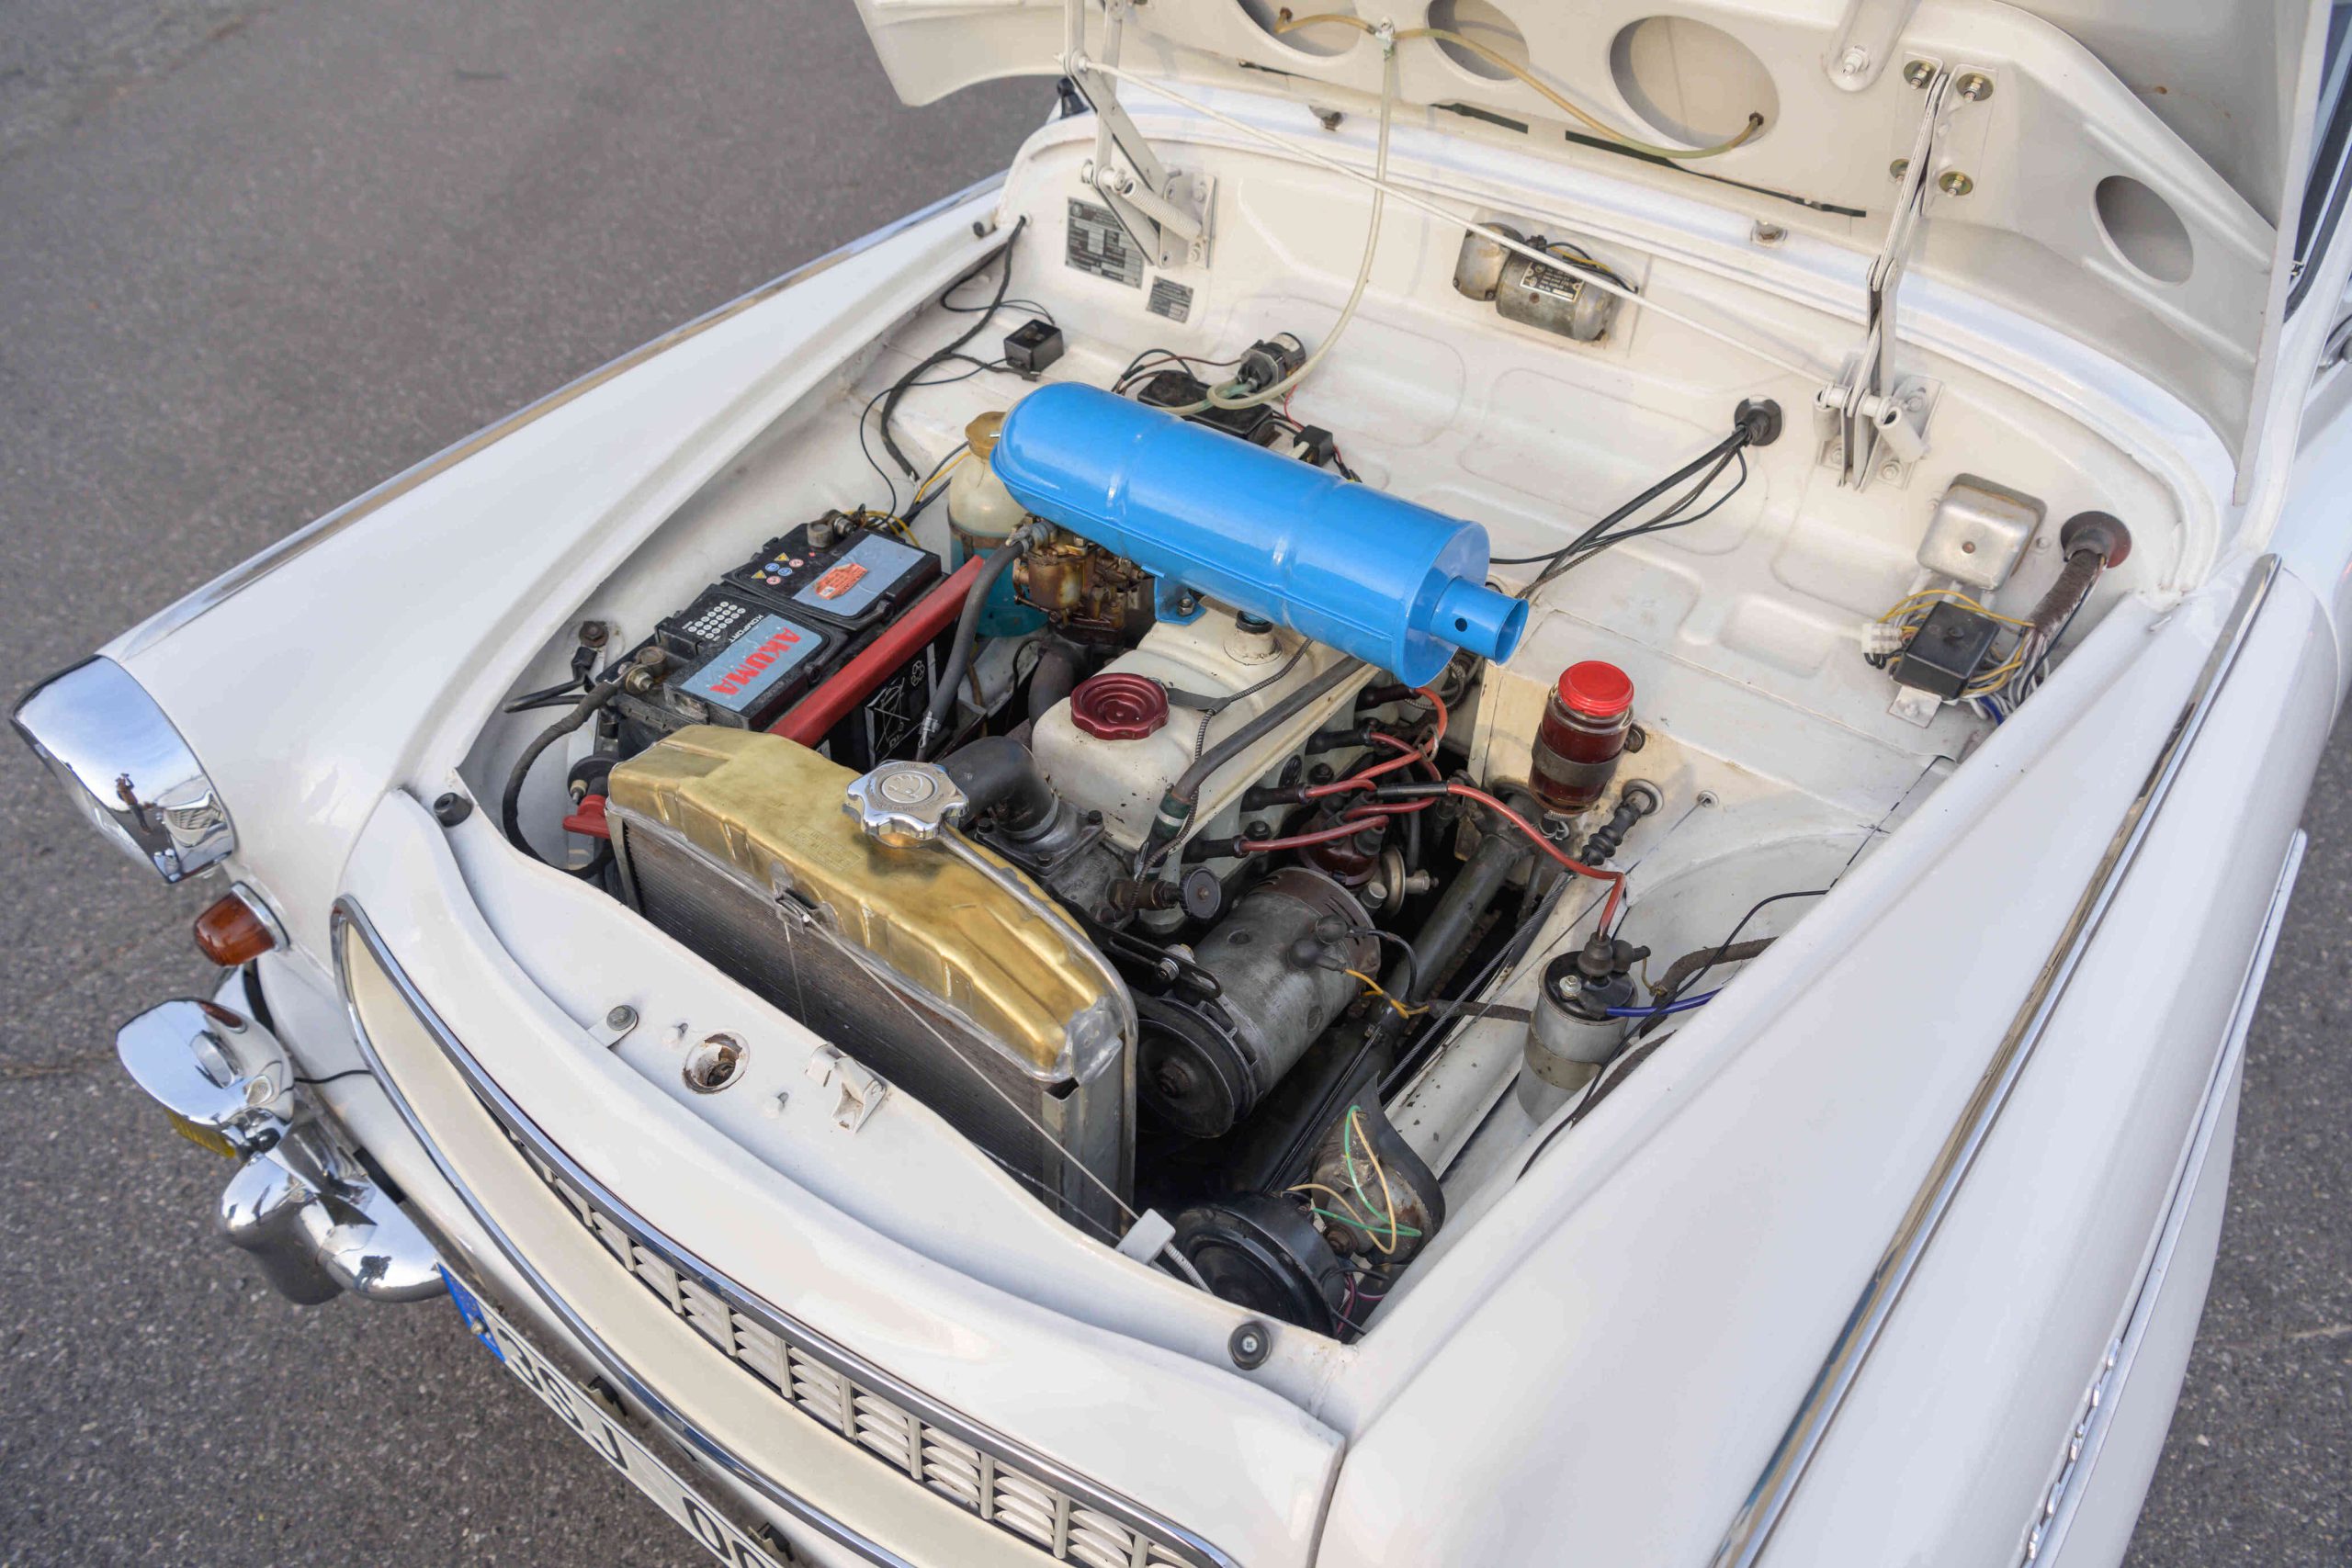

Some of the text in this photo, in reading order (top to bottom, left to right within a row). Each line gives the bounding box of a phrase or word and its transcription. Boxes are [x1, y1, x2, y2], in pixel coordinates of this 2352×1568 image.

[710, 628, 802, 695] AKUMA
[729, 615, 764, 643] KOMFORT
[498, 1328, 628, 1470] 3SJ
